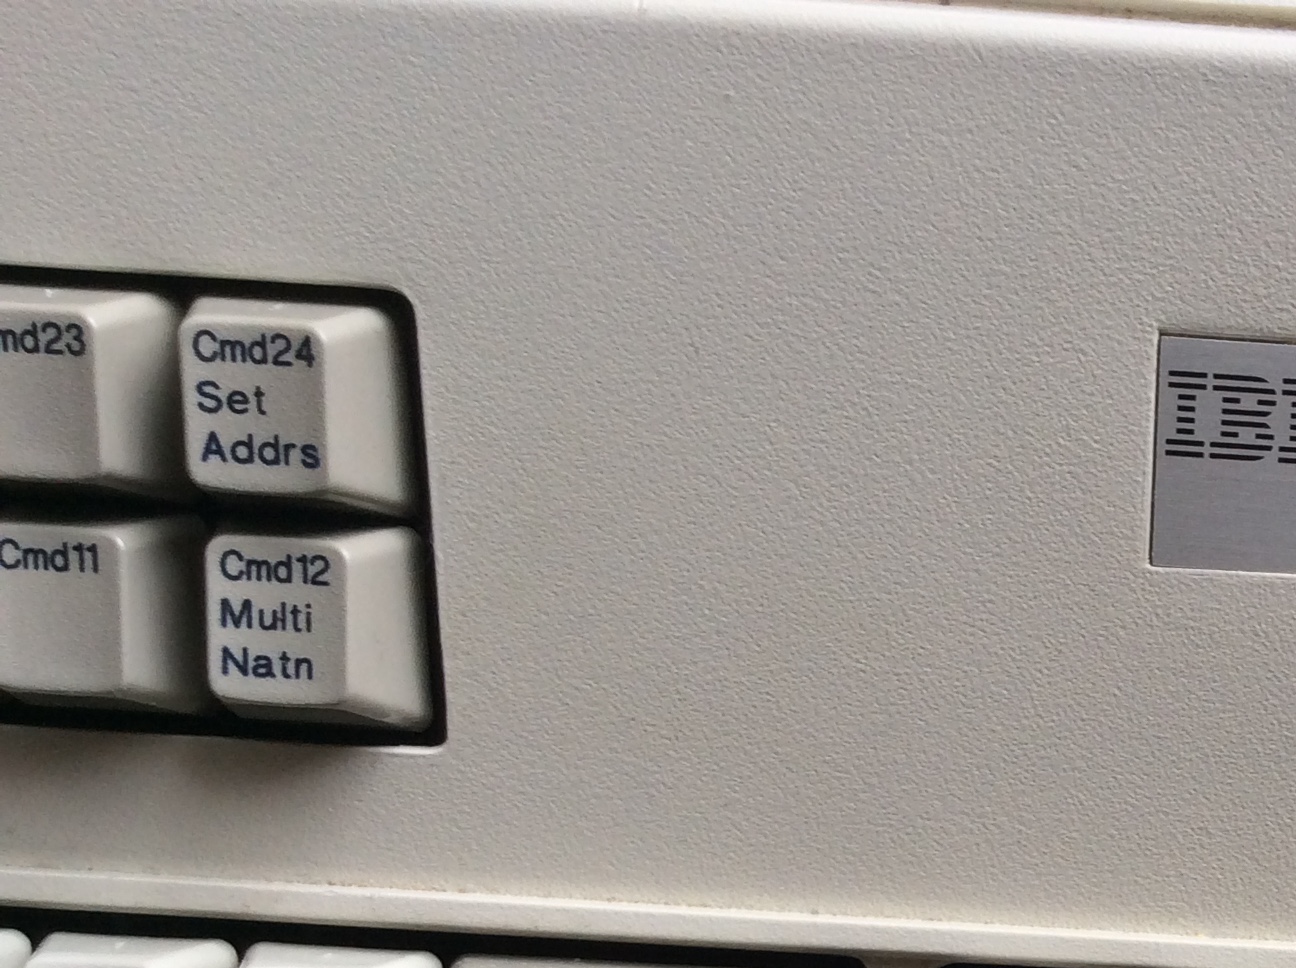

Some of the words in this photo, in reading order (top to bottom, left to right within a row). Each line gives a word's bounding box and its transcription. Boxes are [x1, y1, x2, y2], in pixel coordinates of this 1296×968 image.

[0, 320, 87, 357] md23
[193, 329, 316, 368] Cmd24
[195, 380, 267, 415] Set
[201, 431, 321, 469] Addrs
[0, 537, 99, 574] Cmd11
[220, 549, 331, 587] Cmd12
[219, 598, 313, 633] Multi
[220, 646, 315, 681] Natn
